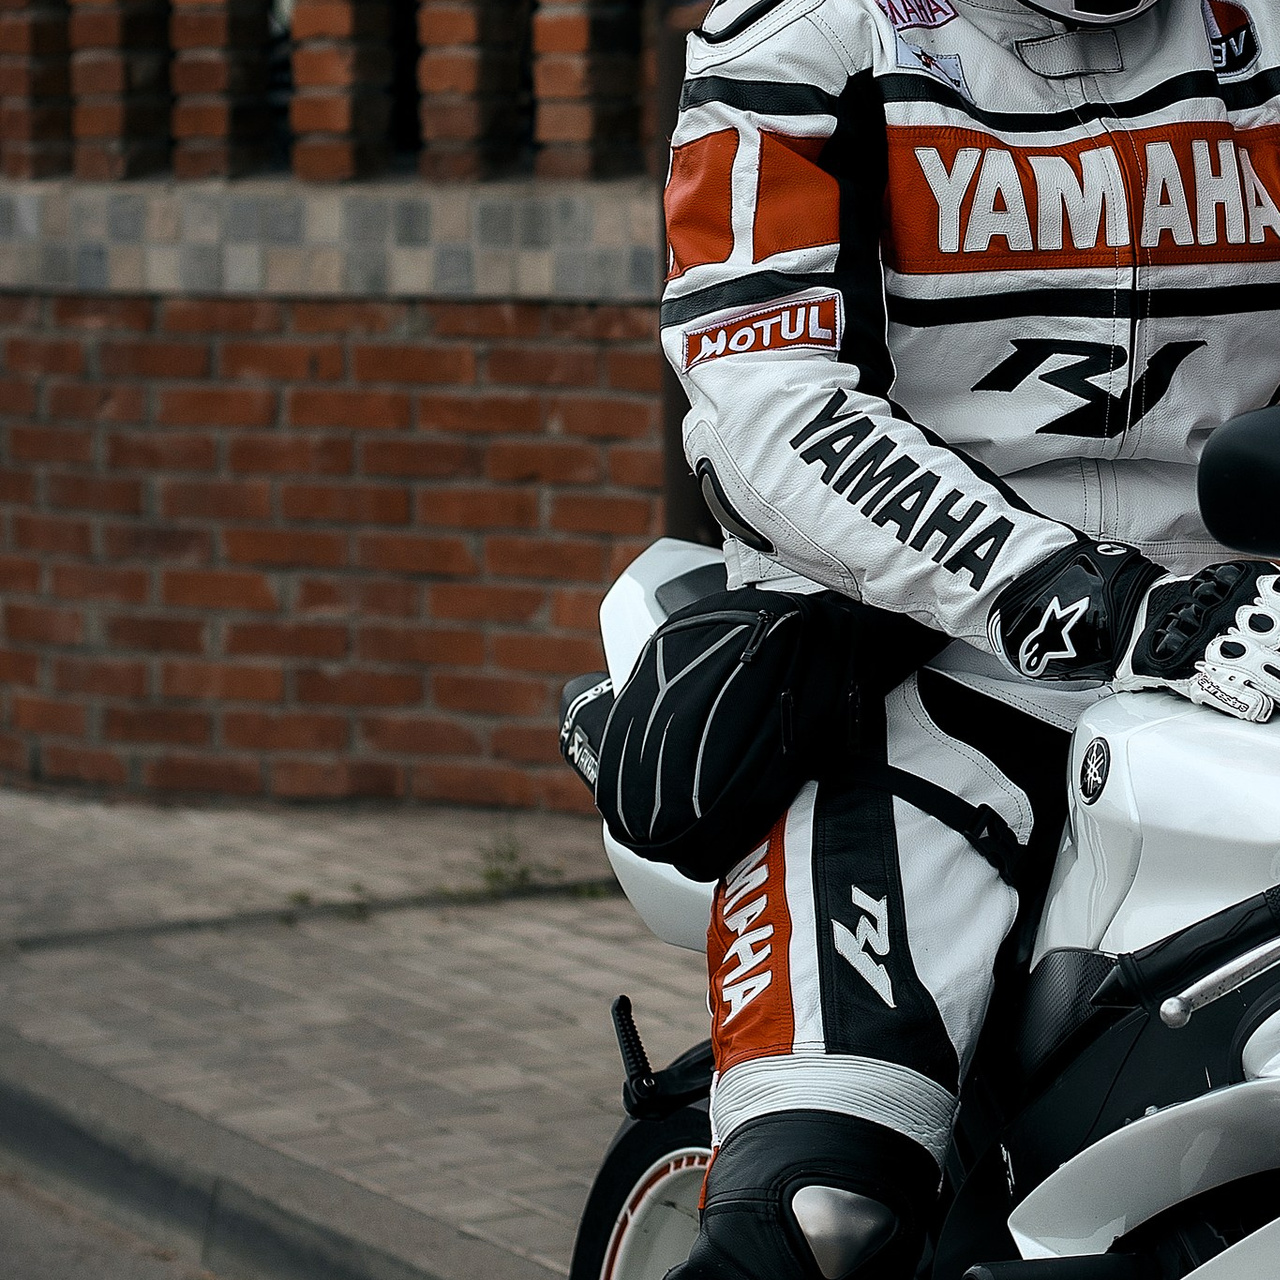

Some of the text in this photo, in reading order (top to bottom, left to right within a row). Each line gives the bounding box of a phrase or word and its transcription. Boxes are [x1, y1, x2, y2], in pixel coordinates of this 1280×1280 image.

[690, 305, 833, 365] MOTUL
[788, 387, 1016, 592] YAMAHA
[722, 838, 775, 1028] MAHA
